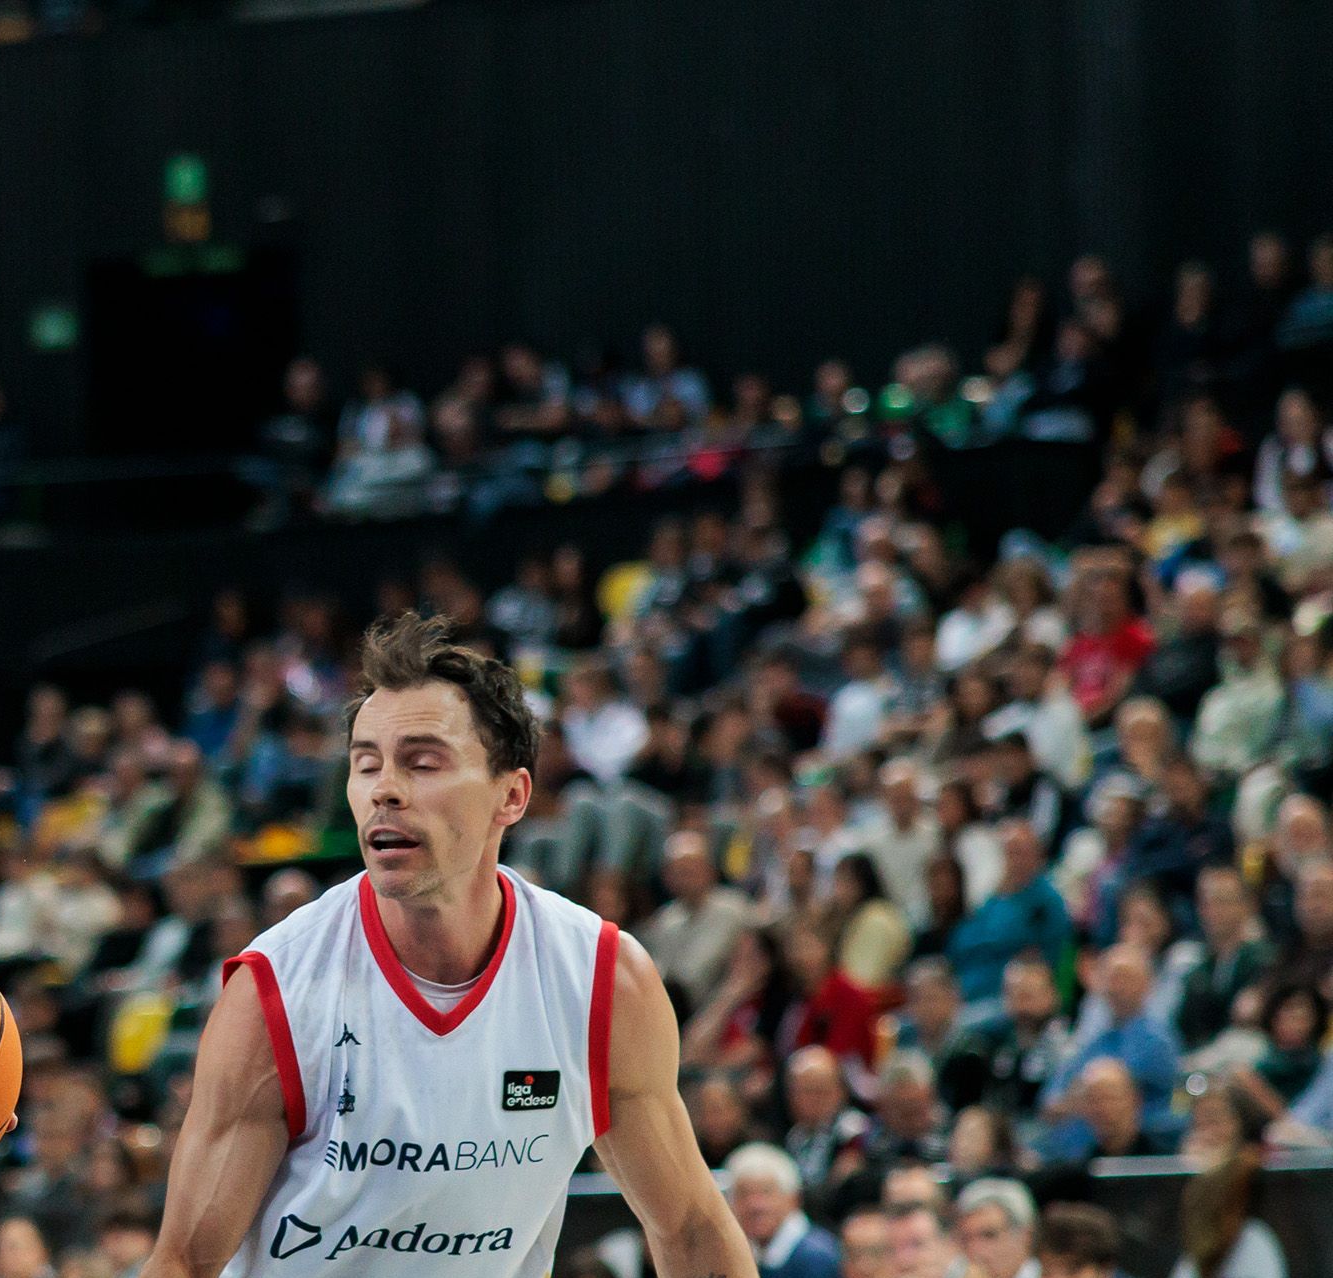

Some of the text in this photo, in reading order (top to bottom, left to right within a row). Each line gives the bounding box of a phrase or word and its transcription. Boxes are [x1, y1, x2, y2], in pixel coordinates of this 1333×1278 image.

[506, 1095, 555, 1107] endesa
[507, 1082, 532, 1097] liga
[339, 1134, 549, 1172] MORABANC
[325, 1222, 513, 1260] Andorra
